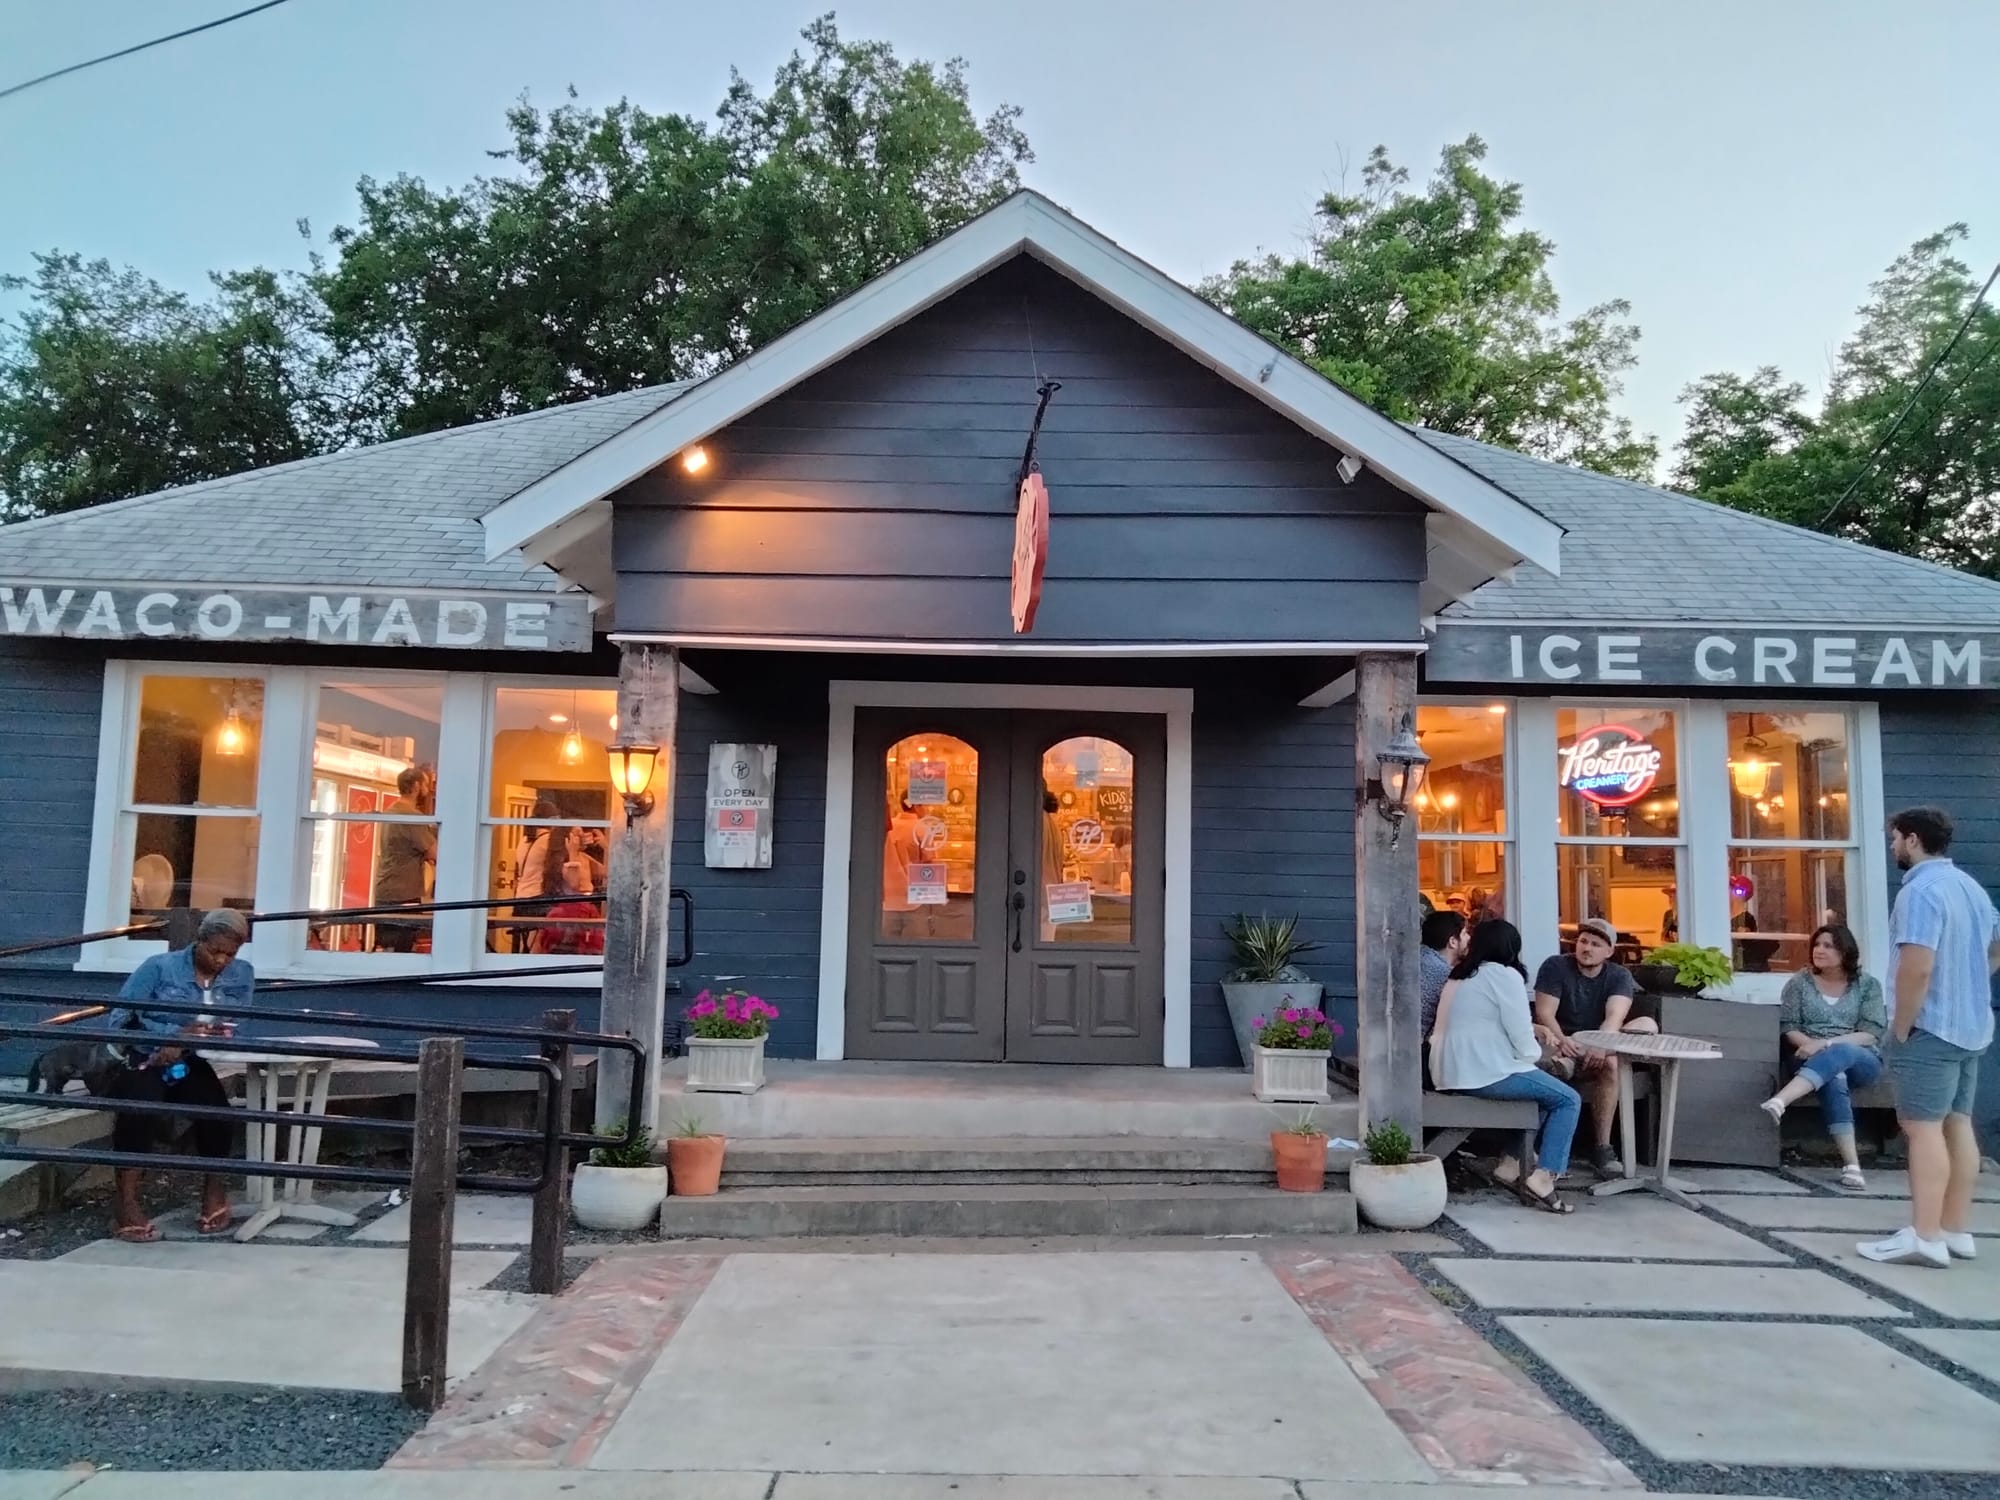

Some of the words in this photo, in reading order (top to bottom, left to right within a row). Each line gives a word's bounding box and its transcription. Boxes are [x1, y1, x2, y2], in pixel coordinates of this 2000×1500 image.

[0, 587, 551, 648] WACO-MADE
[1510, 634, 1642, 680] ICE
[1694, 635, 1981, 685] CREAM
[1558, 737, 1661, 793] Heritage
[1574, 773, 1629, 790] CREAMERY
[713, 799, 742, 807] EVERY
[745, 799, 764, 807] DAY
[724, 788, 756, 798] OPEN
